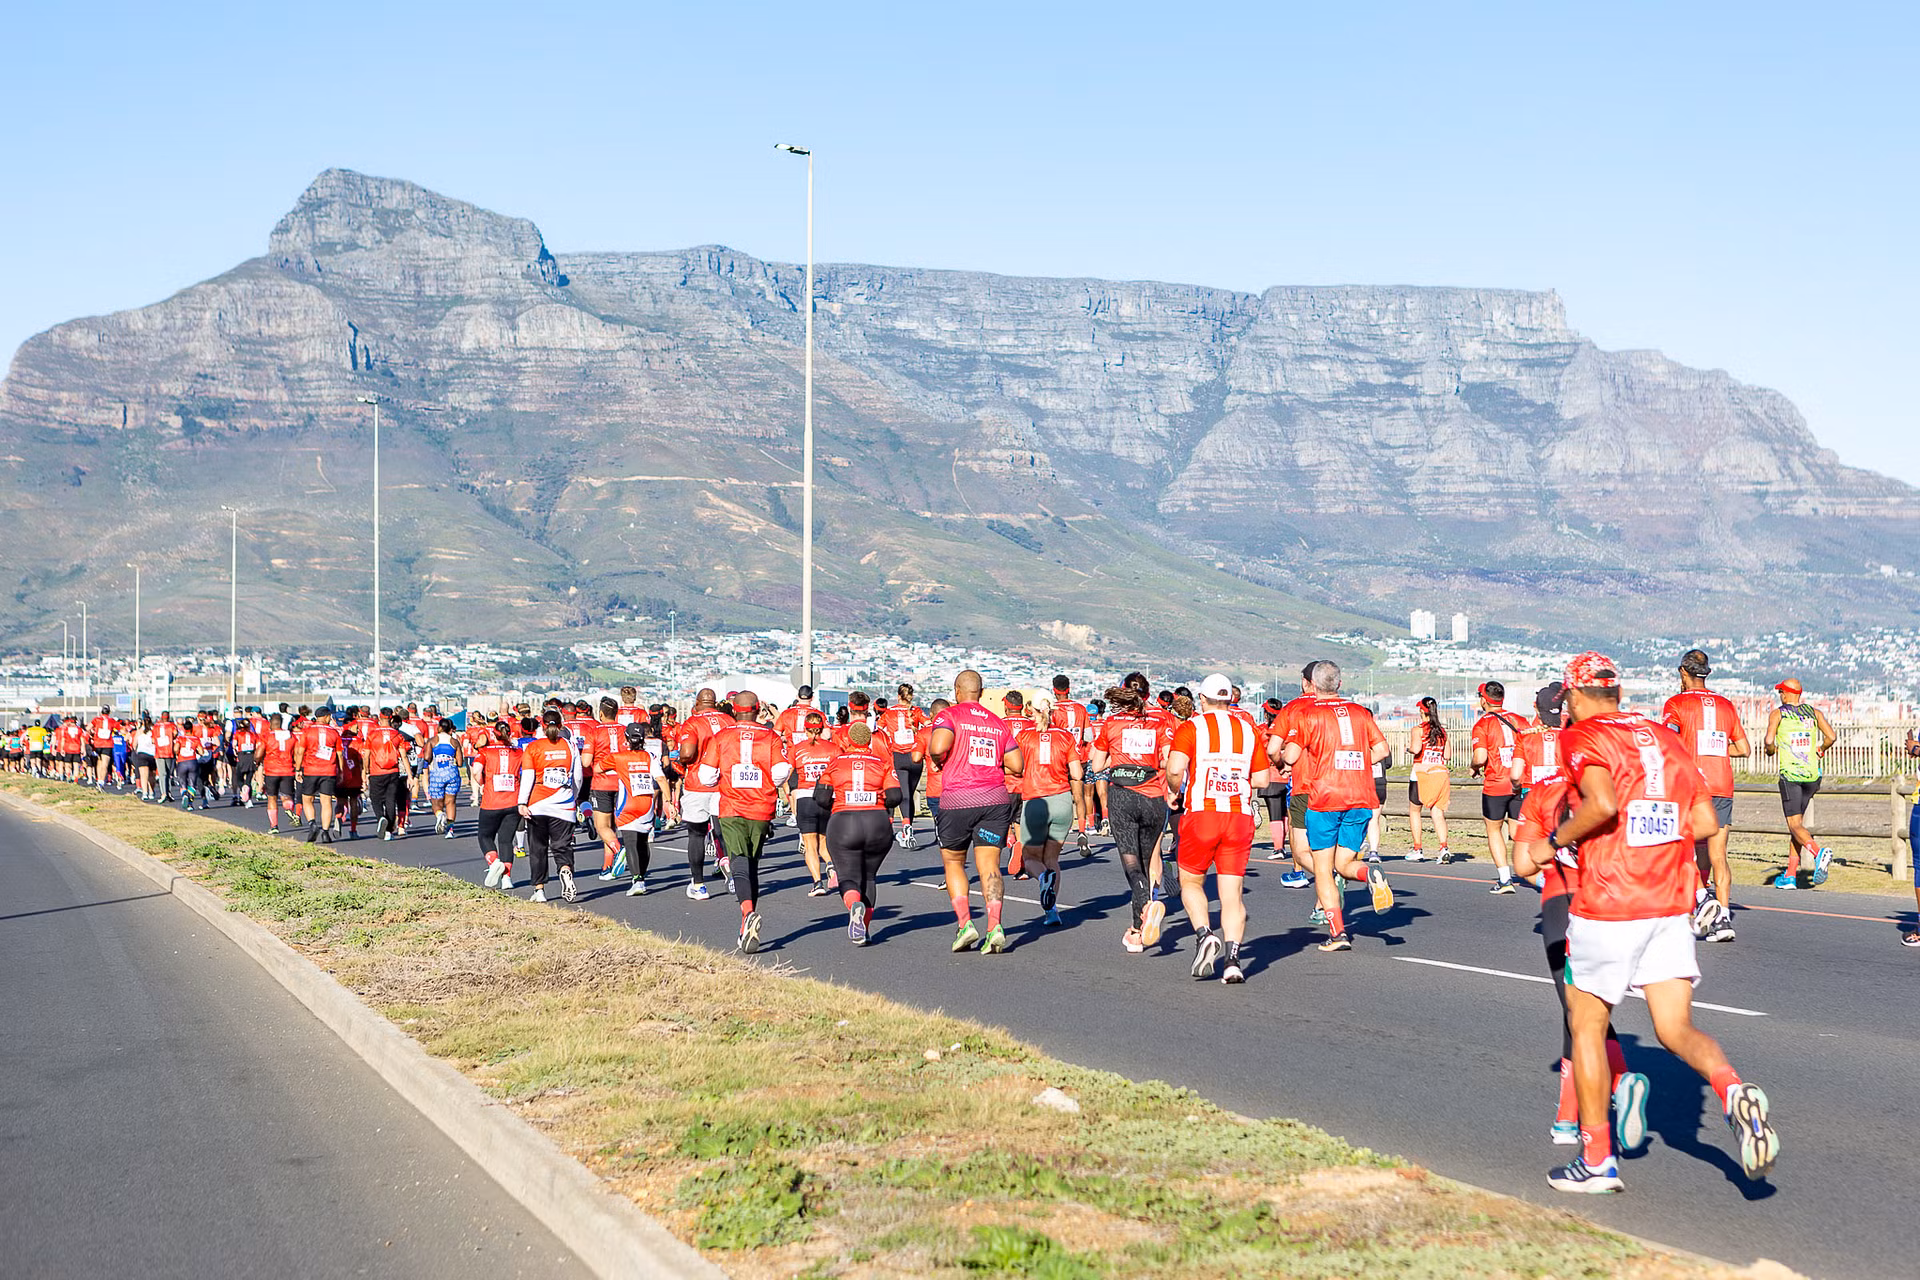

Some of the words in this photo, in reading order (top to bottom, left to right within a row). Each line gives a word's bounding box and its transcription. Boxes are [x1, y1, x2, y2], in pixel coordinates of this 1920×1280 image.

[960, 723, 976, 731] TEAM
[976, 725, 1003, 737] VITALITY
[969, 745, 975, 756] P
[739, 771, 759, 782] 9528
[1208, 779, 1214, 791] P
[1215, 780, 1239, 793] 6553
[854, 792, 872, 803] 9527
[1630, 816, 1637, 834] T
[1639, 816, 1675, 836] 30457
